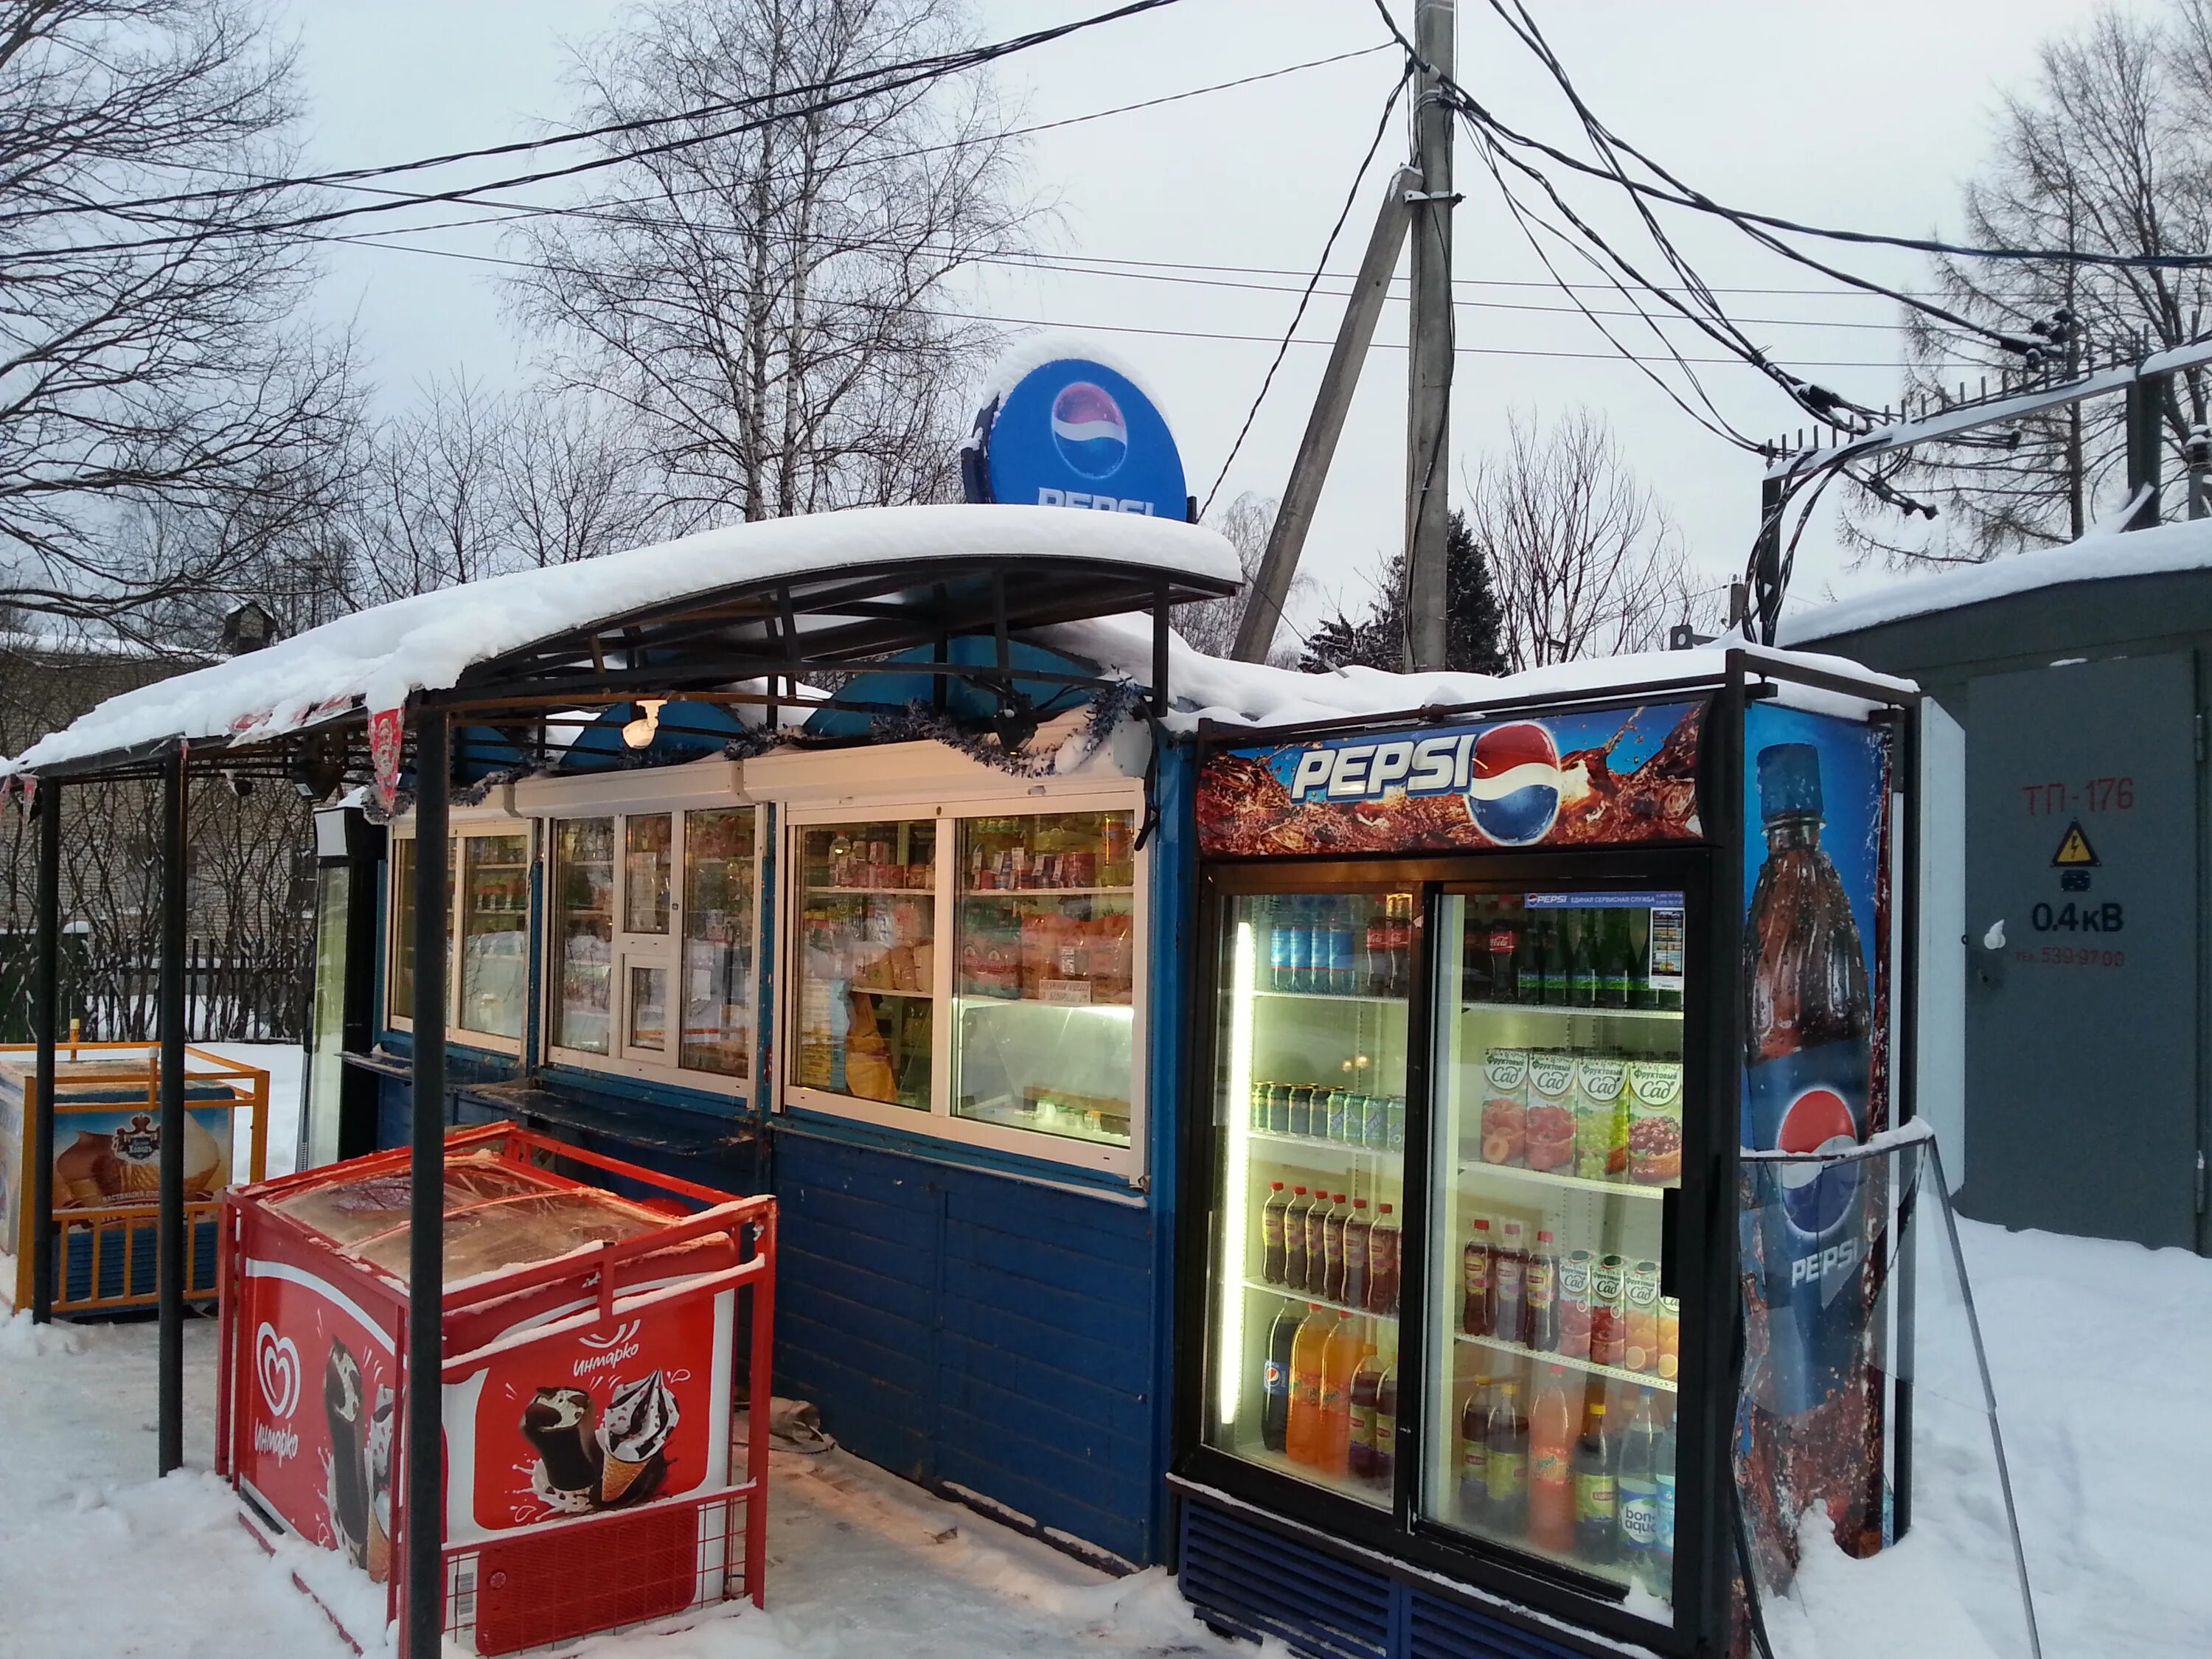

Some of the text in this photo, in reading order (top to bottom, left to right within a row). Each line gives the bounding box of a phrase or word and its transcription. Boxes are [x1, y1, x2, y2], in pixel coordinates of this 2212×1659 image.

[1291, 734, 1477, 799] PEPSI
[1537, 895, 1568, 904] PEPSI
[1487, 1055, 1524, 1066] Фруктовый
[1532, 1060, 1571, 1071] Фруктовый
[1492, 1066, 1520, 1084] Сад
[1582, 1065, 1622, 1076] Фруктовый
[1634, 1069, 1677, 1079] Фруктовый
[1537, 1071, 1565, 1090] Сад
[1587, 1076, 1617, 1095] Сад
[1639, 1080, 1671, 1099] Сад
[1792, 1237, 1858, 1288] PEPSI
[1565, 1274, 1585, 1289] Сад
[1596, 1280, 1618, 1295] Сад
[1630, 1286, 1652, 1301] Сад
